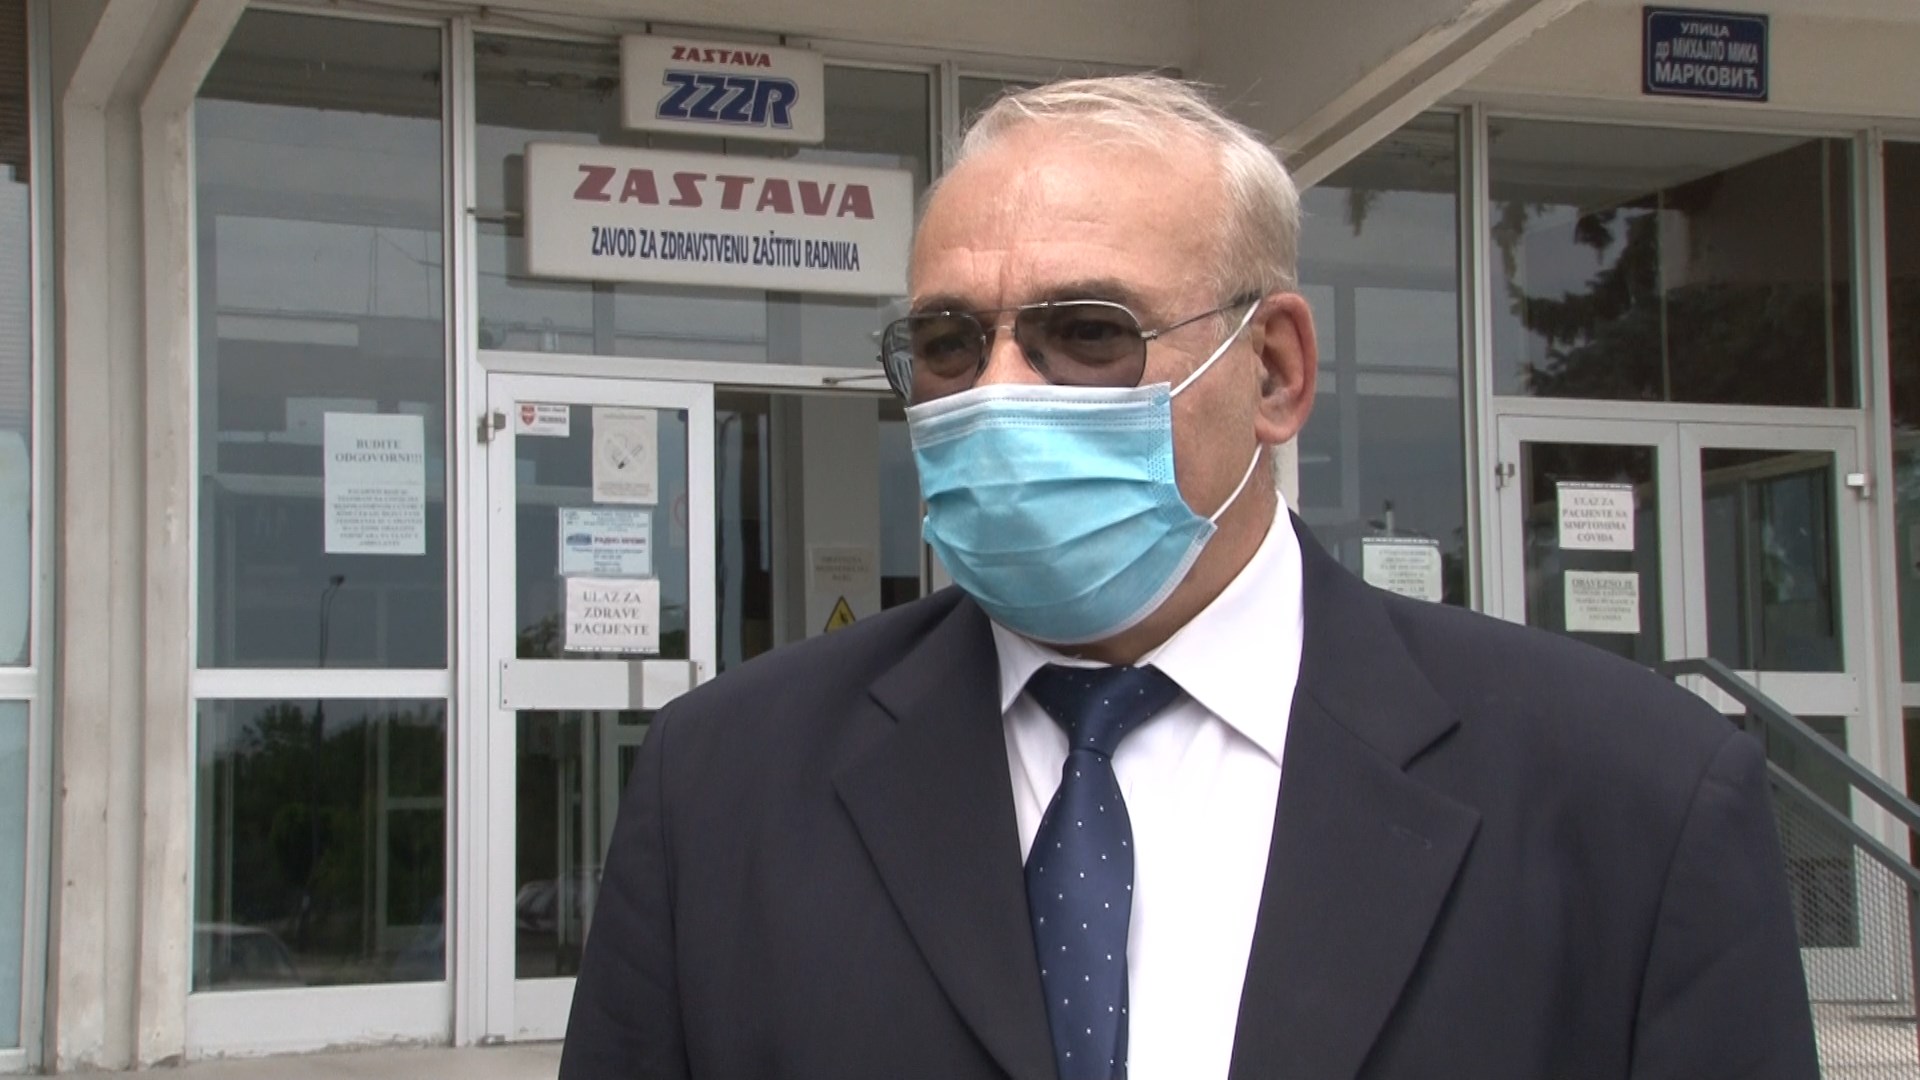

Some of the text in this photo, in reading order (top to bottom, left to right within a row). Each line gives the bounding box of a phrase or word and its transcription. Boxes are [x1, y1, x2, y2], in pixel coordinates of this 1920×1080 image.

[1680, 21, 1730, 37] УЛИЦА
[671, 46, 772, 68] ZASTAVA
[1672, 37, 1725, 61] МИХАЈЛО
[1728, 41, 1758, 64] МИКА
[1655, 62, 1758, 89] МАРКОВИЋ
[655, 69, 799, 130] ZZZR
[573, 164, 874, 220] ZASTAVA
[591, 227, 860, 271] ZAVOD ZA ZDRAVSTVENU ZAŠTITU RADNIKA
[356, 439, 400, 449] BUDITE
[1573, 497, 1614, 506] ULAZ ZA
[1562, 509, 1613, 518] PACIJENTE
[1564, 521, 1626, 530] SIMPTOMIMA
[1577, 533, 1614, 542] COVIDA
[583, 591, 641, 603] ULAZ ZA
[584, 607, 639, 619] ZDRAVE
[574, 622, 650, 636] PACIJENTE
